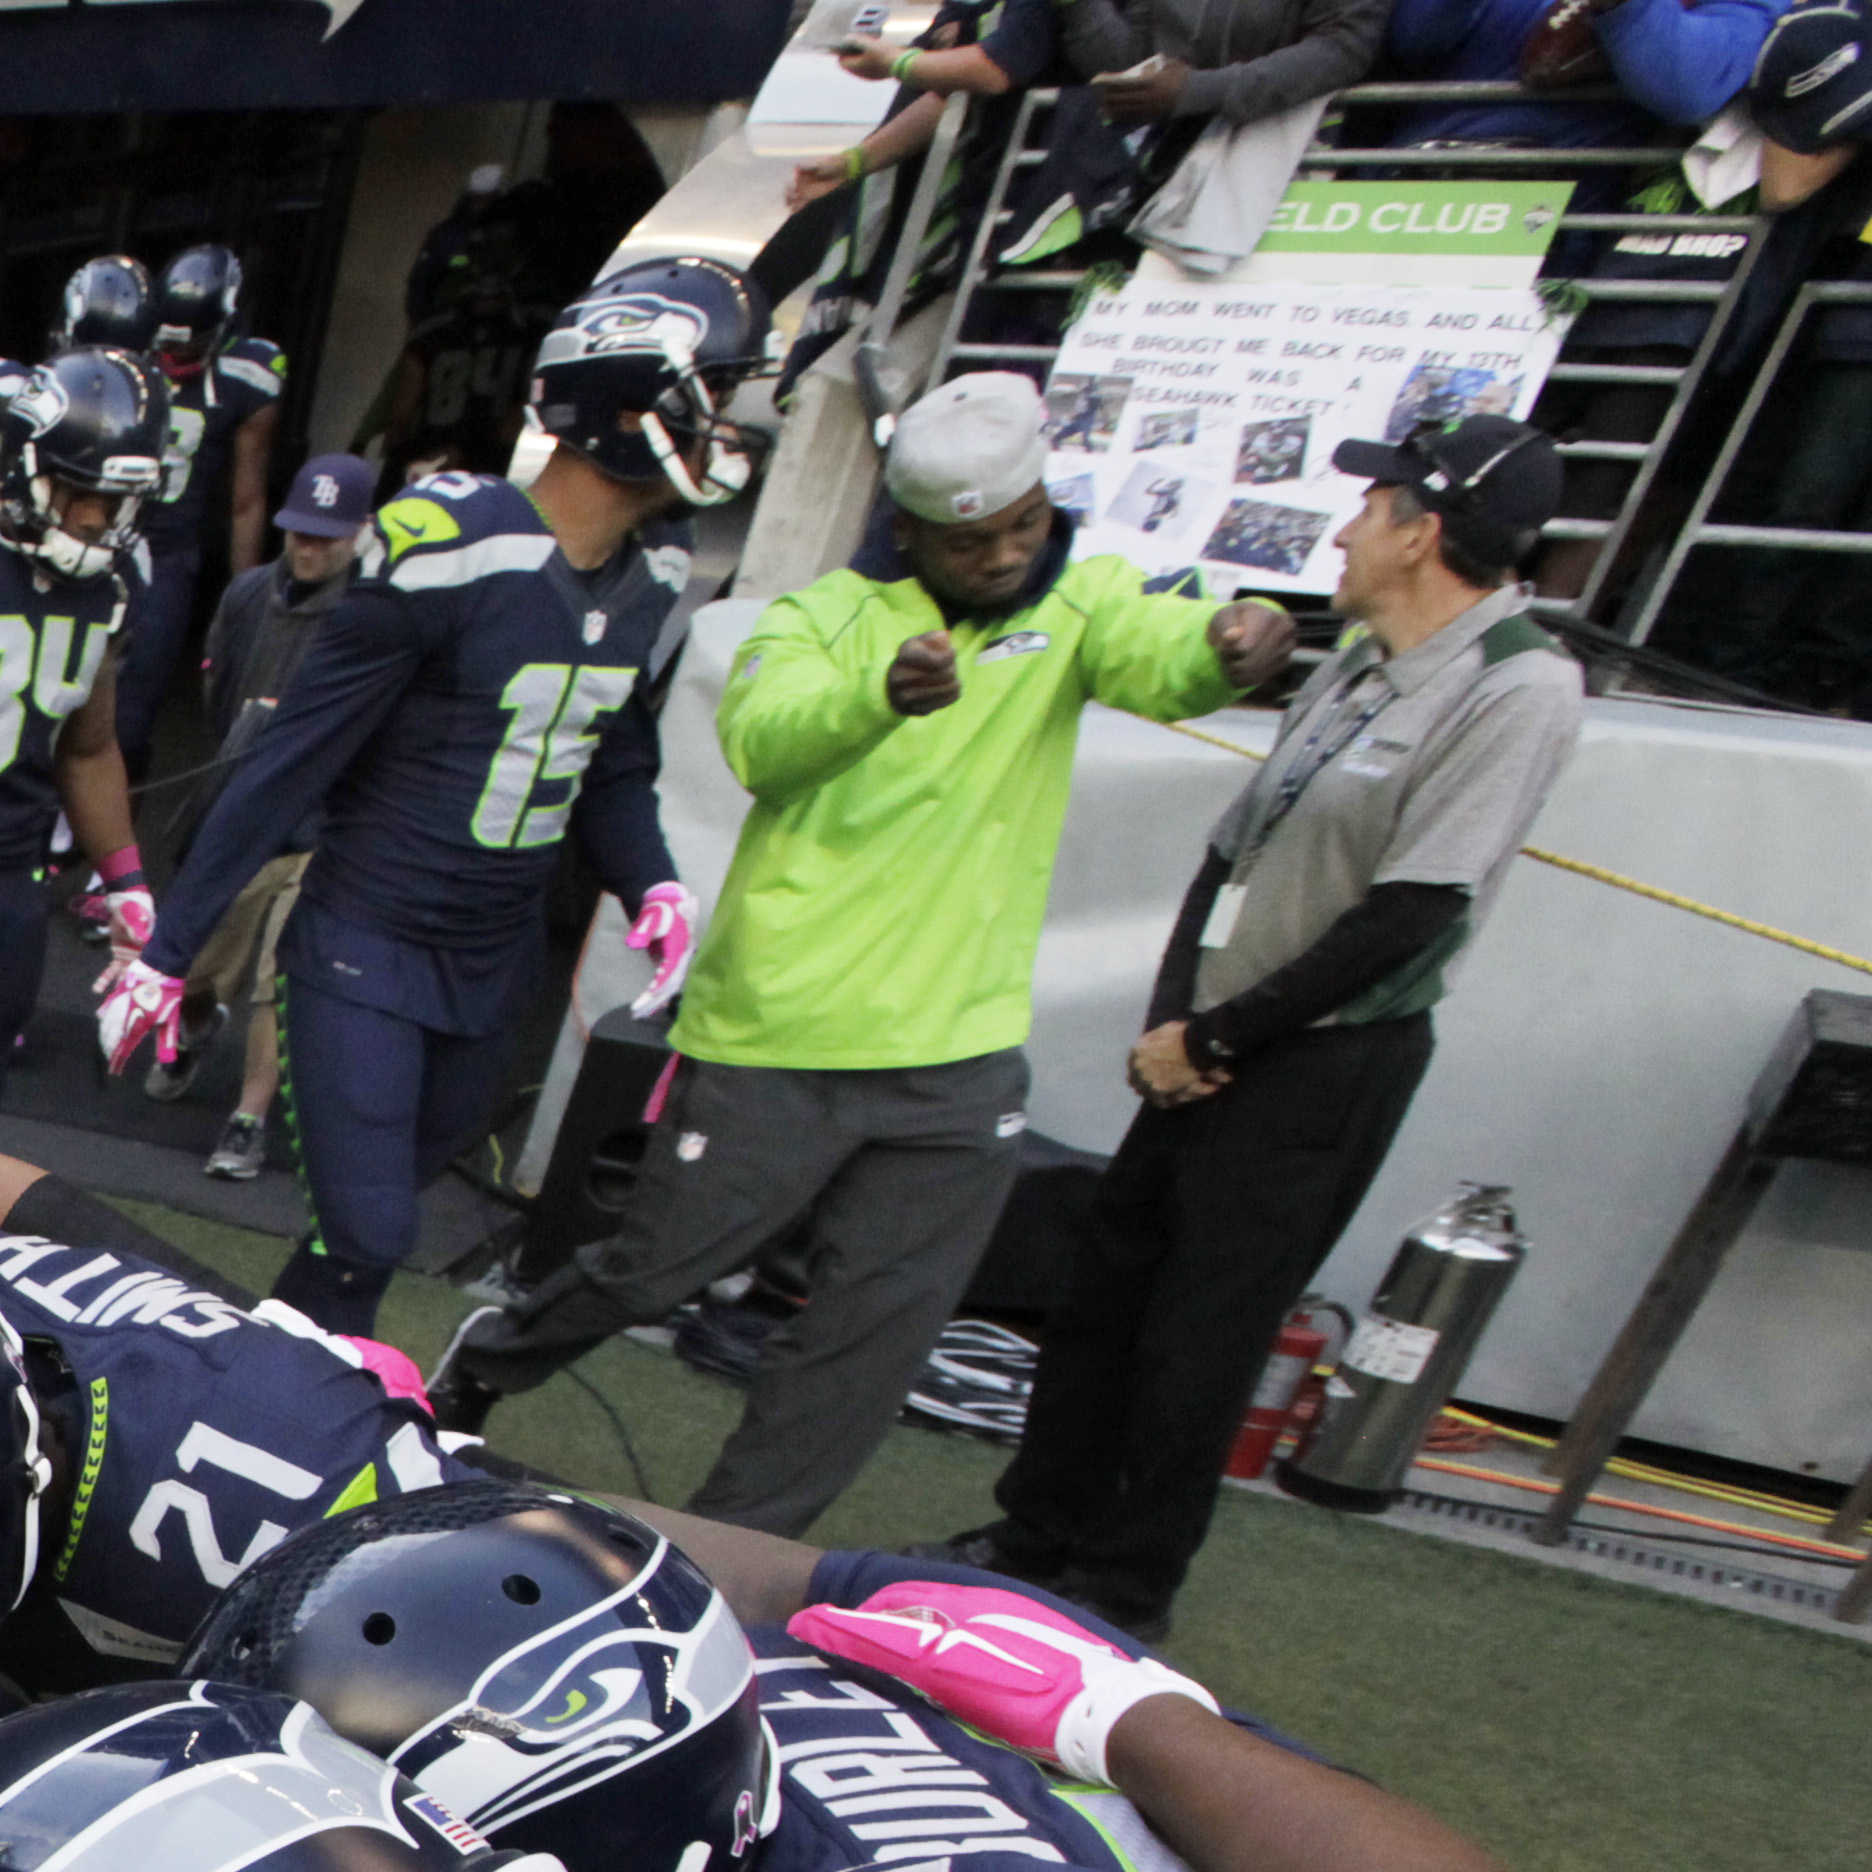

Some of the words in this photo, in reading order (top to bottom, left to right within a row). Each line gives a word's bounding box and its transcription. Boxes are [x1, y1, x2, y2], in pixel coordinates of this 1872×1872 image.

[1367, 202, 1511, 234] CLUB
[1094, 300, 1130, 315] MY
[1143, 301, 1200, 317] MOM
[1212, 302, 1279, 319] WENT
[1290, 305, 1322, 323] TO
[1424, 312, 1480, 330] AND
[1486, 314, 1534, 332] ALL
[1081, 332, 1124, 351] SHE
[1234, 338, 1270, 355] ME
[1280, 341, 1344, 360] BACK
[1356, 345, 1406, 362] FOR
[1419, 349, 1458, 368] MY
[1469, 352, 1525, 370] 13TH
[1111, 357, 1222, 378] BIRTHDAY
[1246, 368, 1303, 387] WAS
[1344, 376, 1362, 392] A
[470, 662, 640, 849] 15
[129, 1420, 324, 1590] 21
